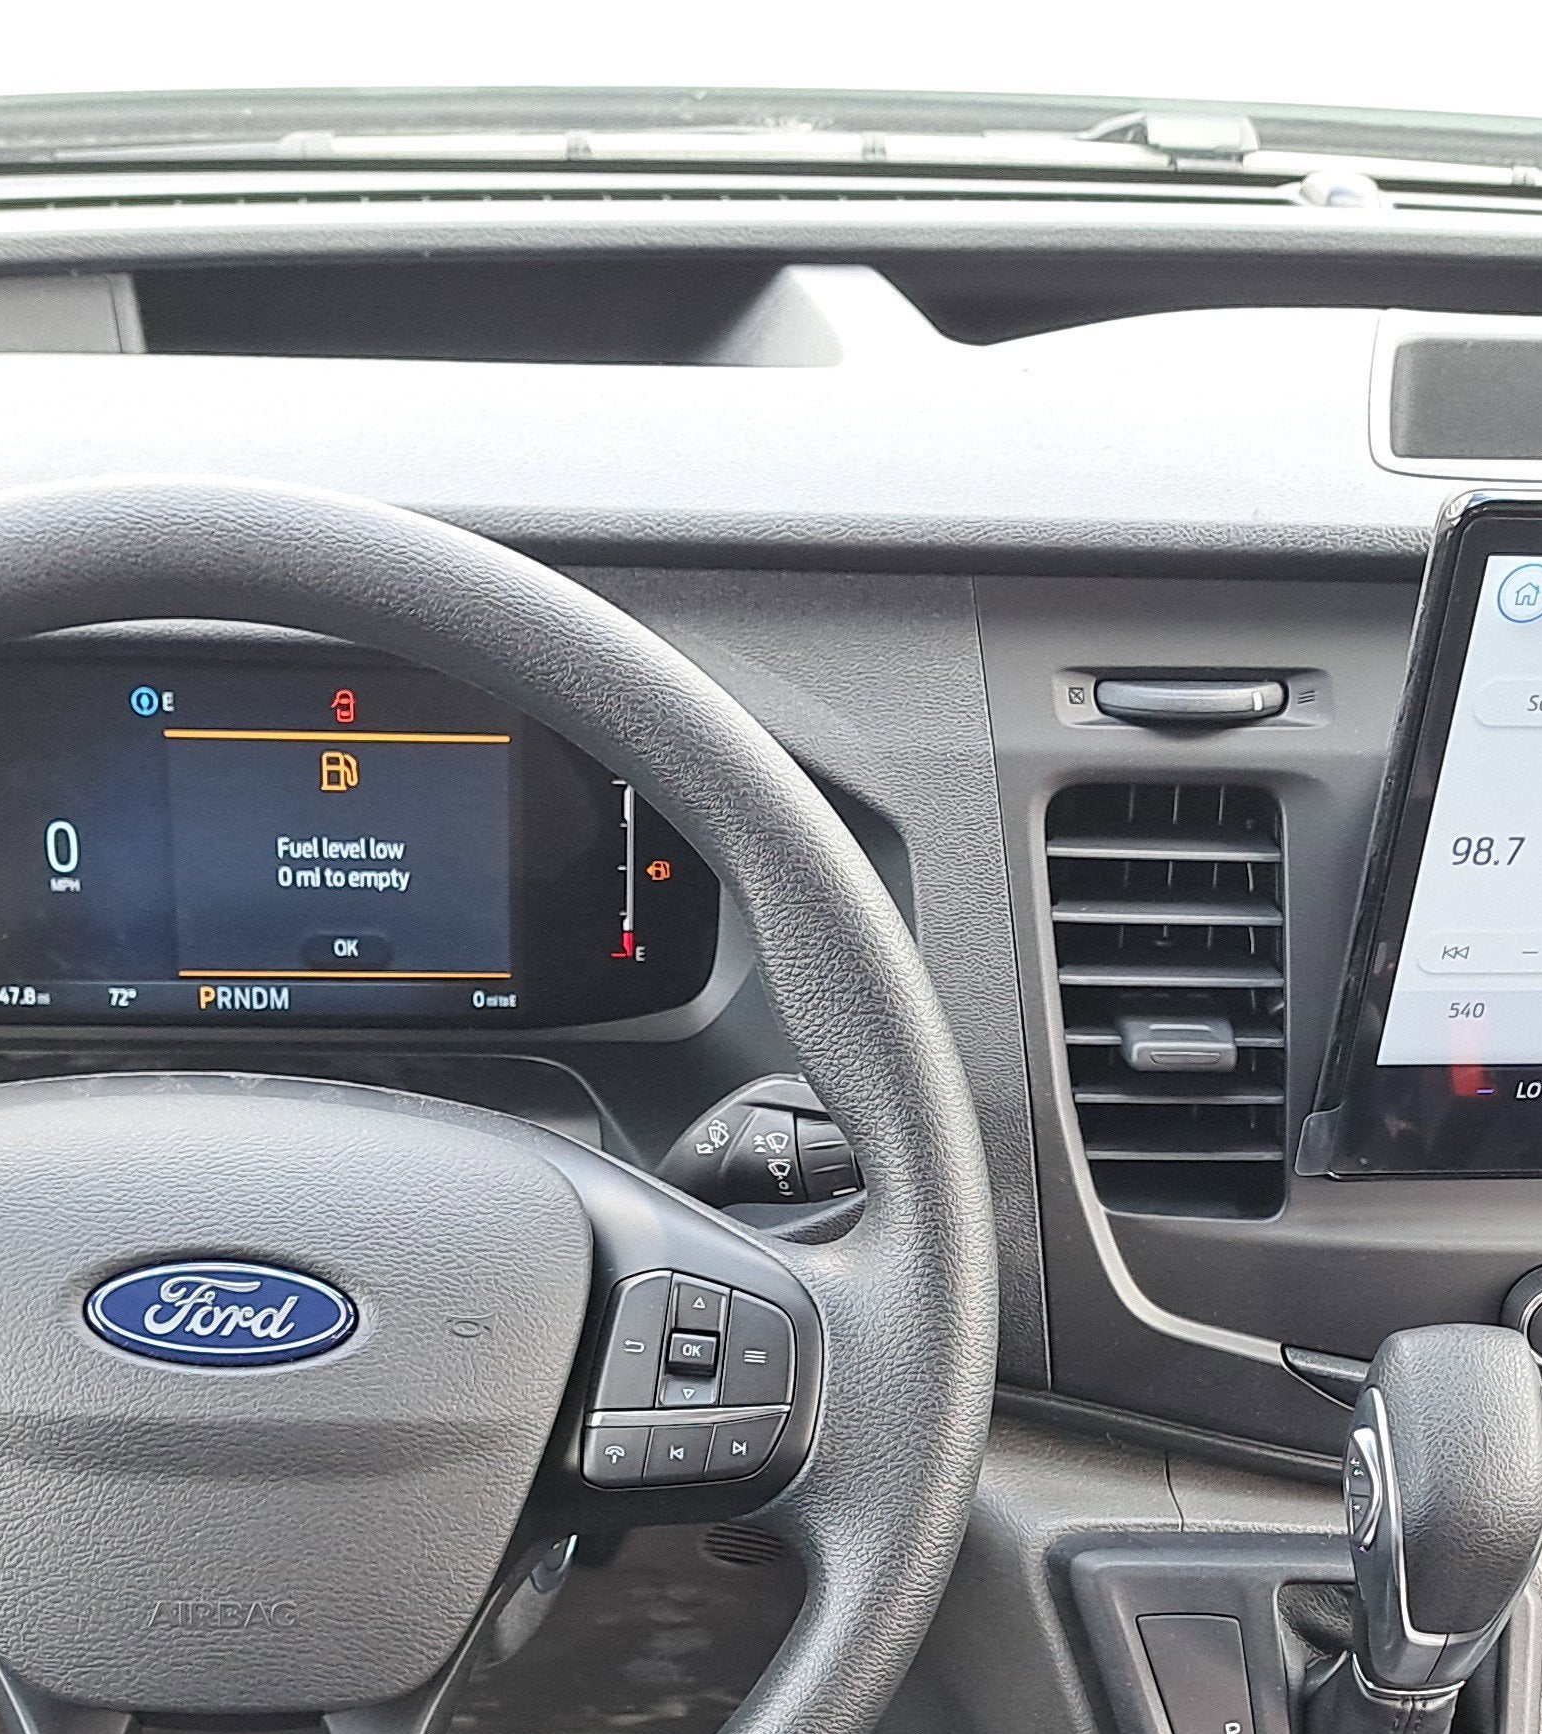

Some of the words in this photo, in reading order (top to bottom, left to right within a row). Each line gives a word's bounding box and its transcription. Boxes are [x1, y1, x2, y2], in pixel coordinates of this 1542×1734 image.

[44, 819, 80, 874] 0
[277, 837, 319, 859] Fuel
[322, 837, 365, 859] level
[368, 837, 405, 860] low
[1450, 836, 1525, 867] 98.7
[278, 867, 292, 888] 0
[324, 868, 345, 888] to
[347, 870, 411, 892] empty
[333, 940, 359, 957] OK
[1447, 1001, 1486, 1019] 540
[1515, 1080, 1542, 1100] LO
[143, 1274, 298, 1340] Ford
[682, 1344, 702, 1358] OK
[145, 1600, 299, 1628] AIRBAG
